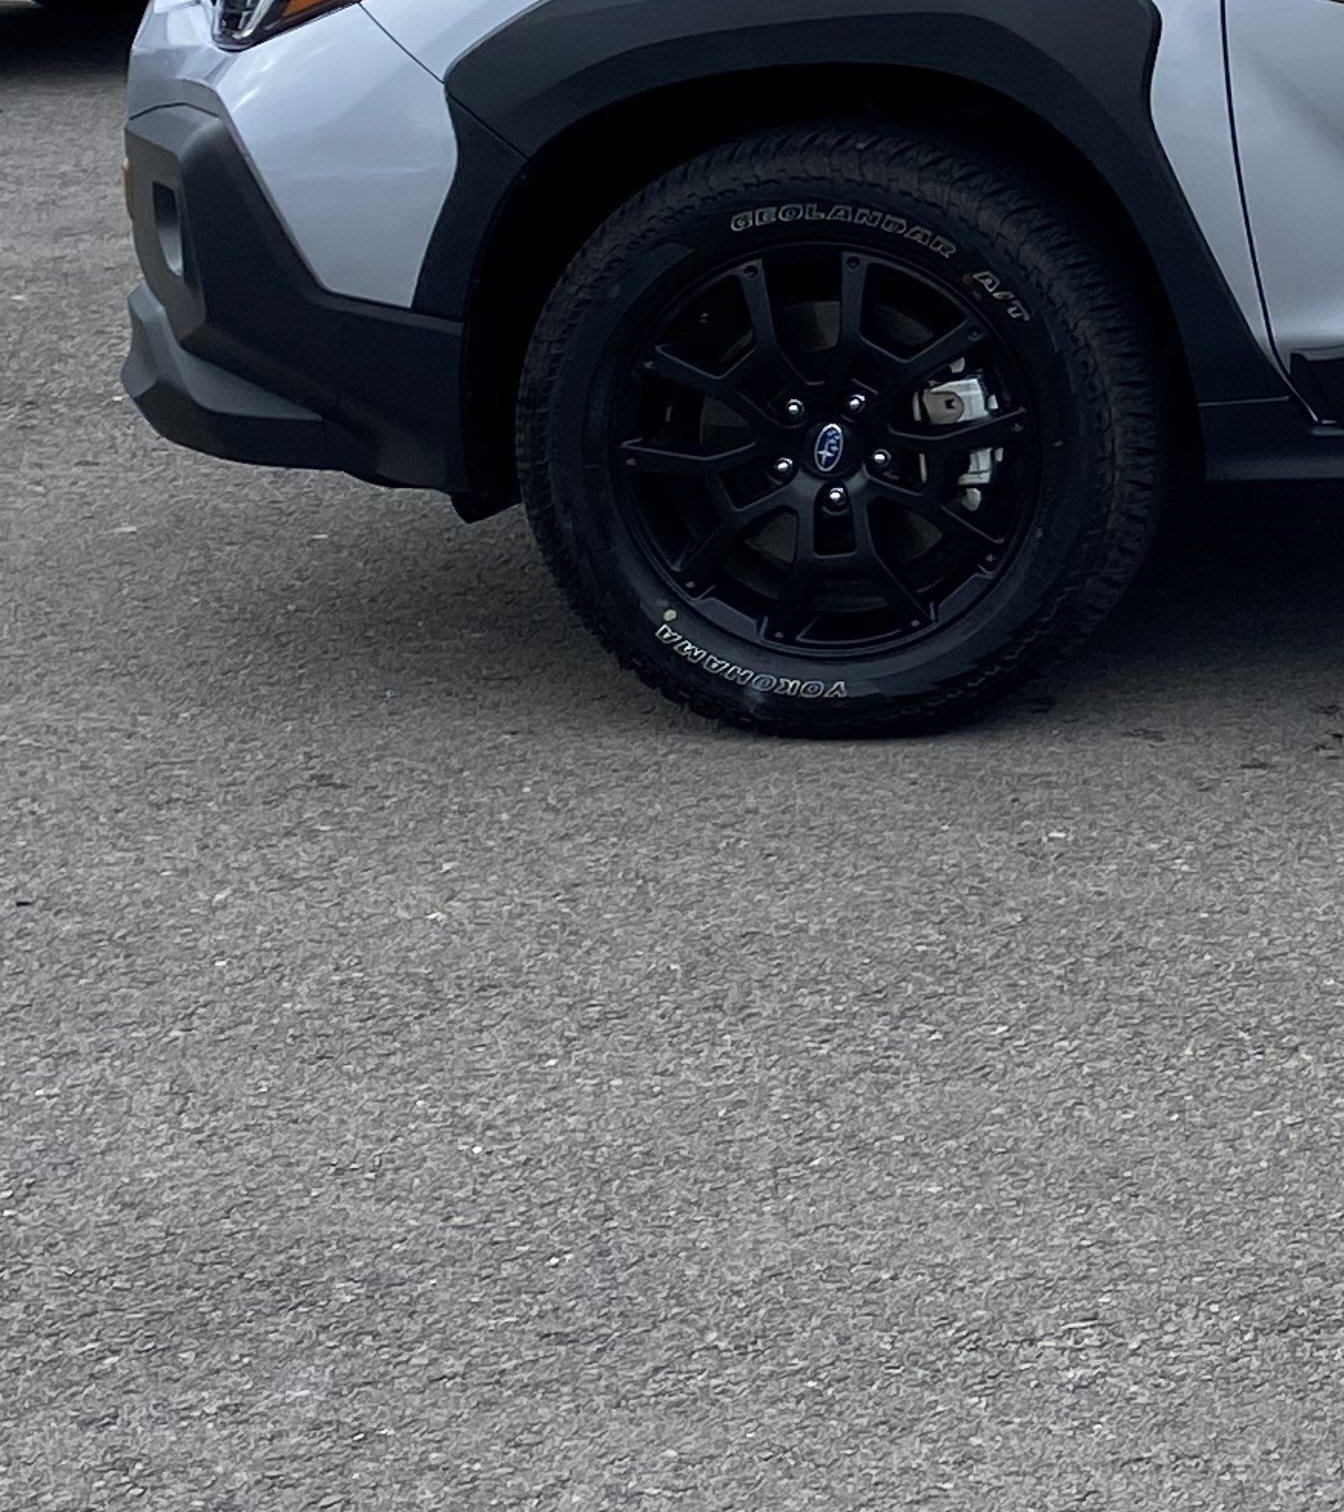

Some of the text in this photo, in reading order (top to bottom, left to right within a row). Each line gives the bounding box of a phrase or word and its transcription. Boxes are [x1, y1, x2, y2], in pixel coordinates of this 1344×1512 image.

[730, 202, 1031, 322] GEOLANDAR A/T
[655, 623, 849, 699] YOKOHAMA
